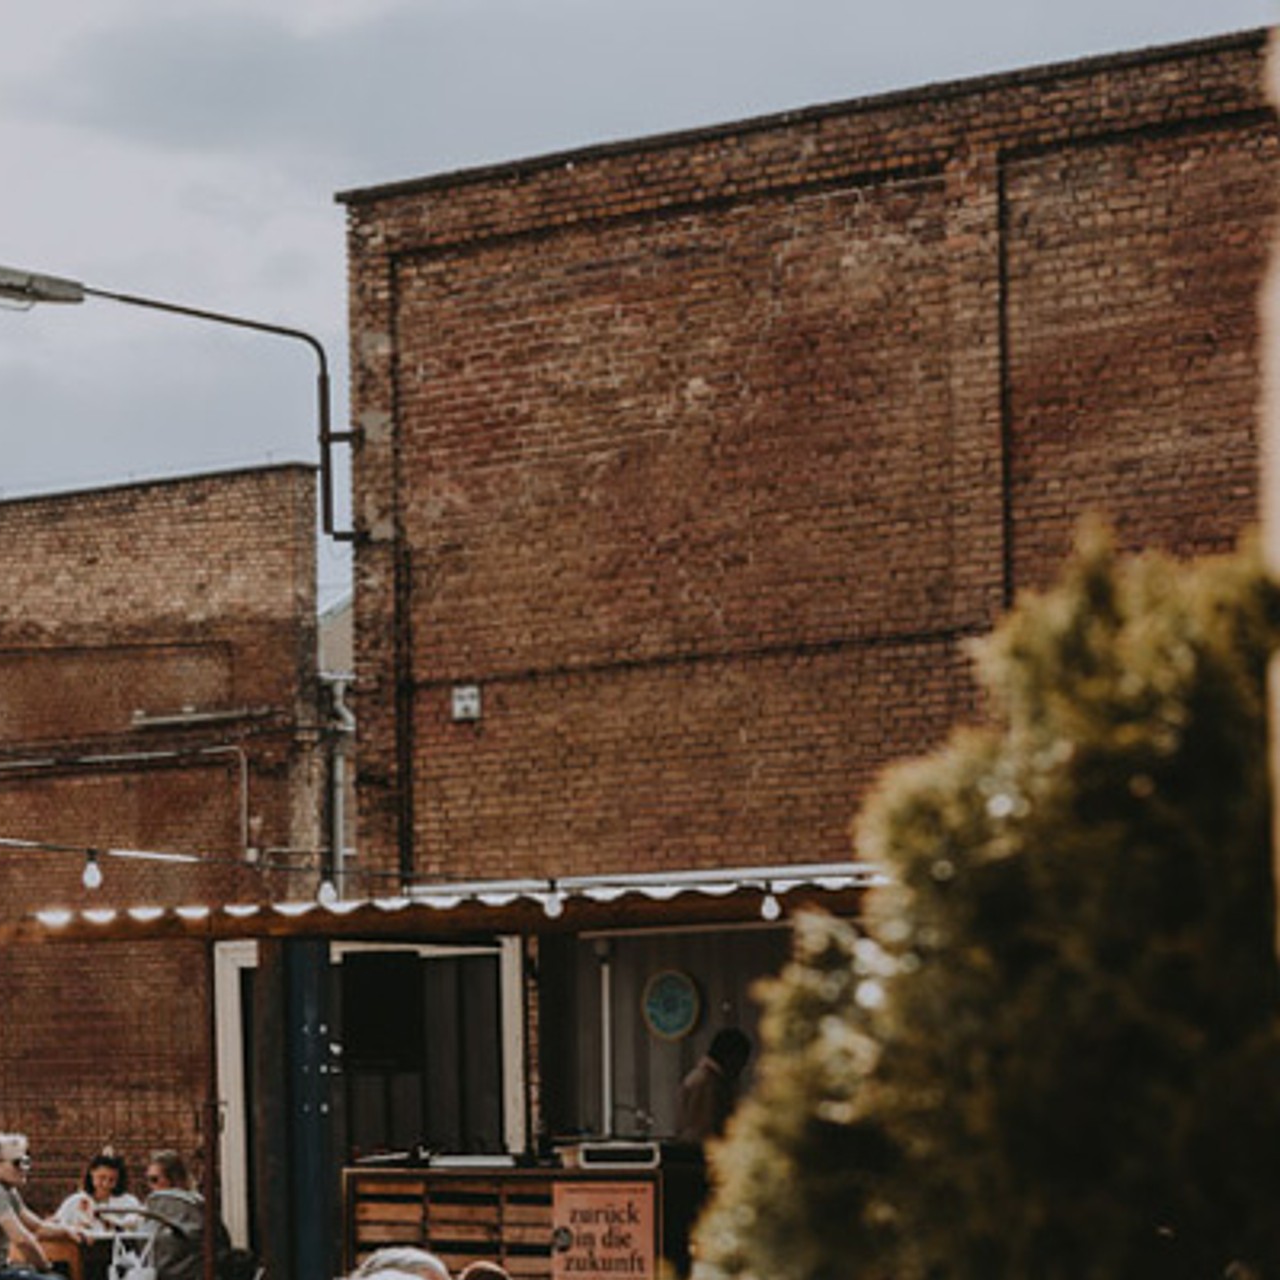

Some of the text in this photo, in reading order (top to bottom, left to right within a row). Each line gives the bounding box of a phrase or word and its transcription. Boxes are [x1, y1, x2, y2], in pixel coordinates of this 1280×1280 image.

[569, 1201, 641, 1224] zurück
[575, 1224, 632, 1249] in die
[564, 1249, 645, 1273] zukunft
